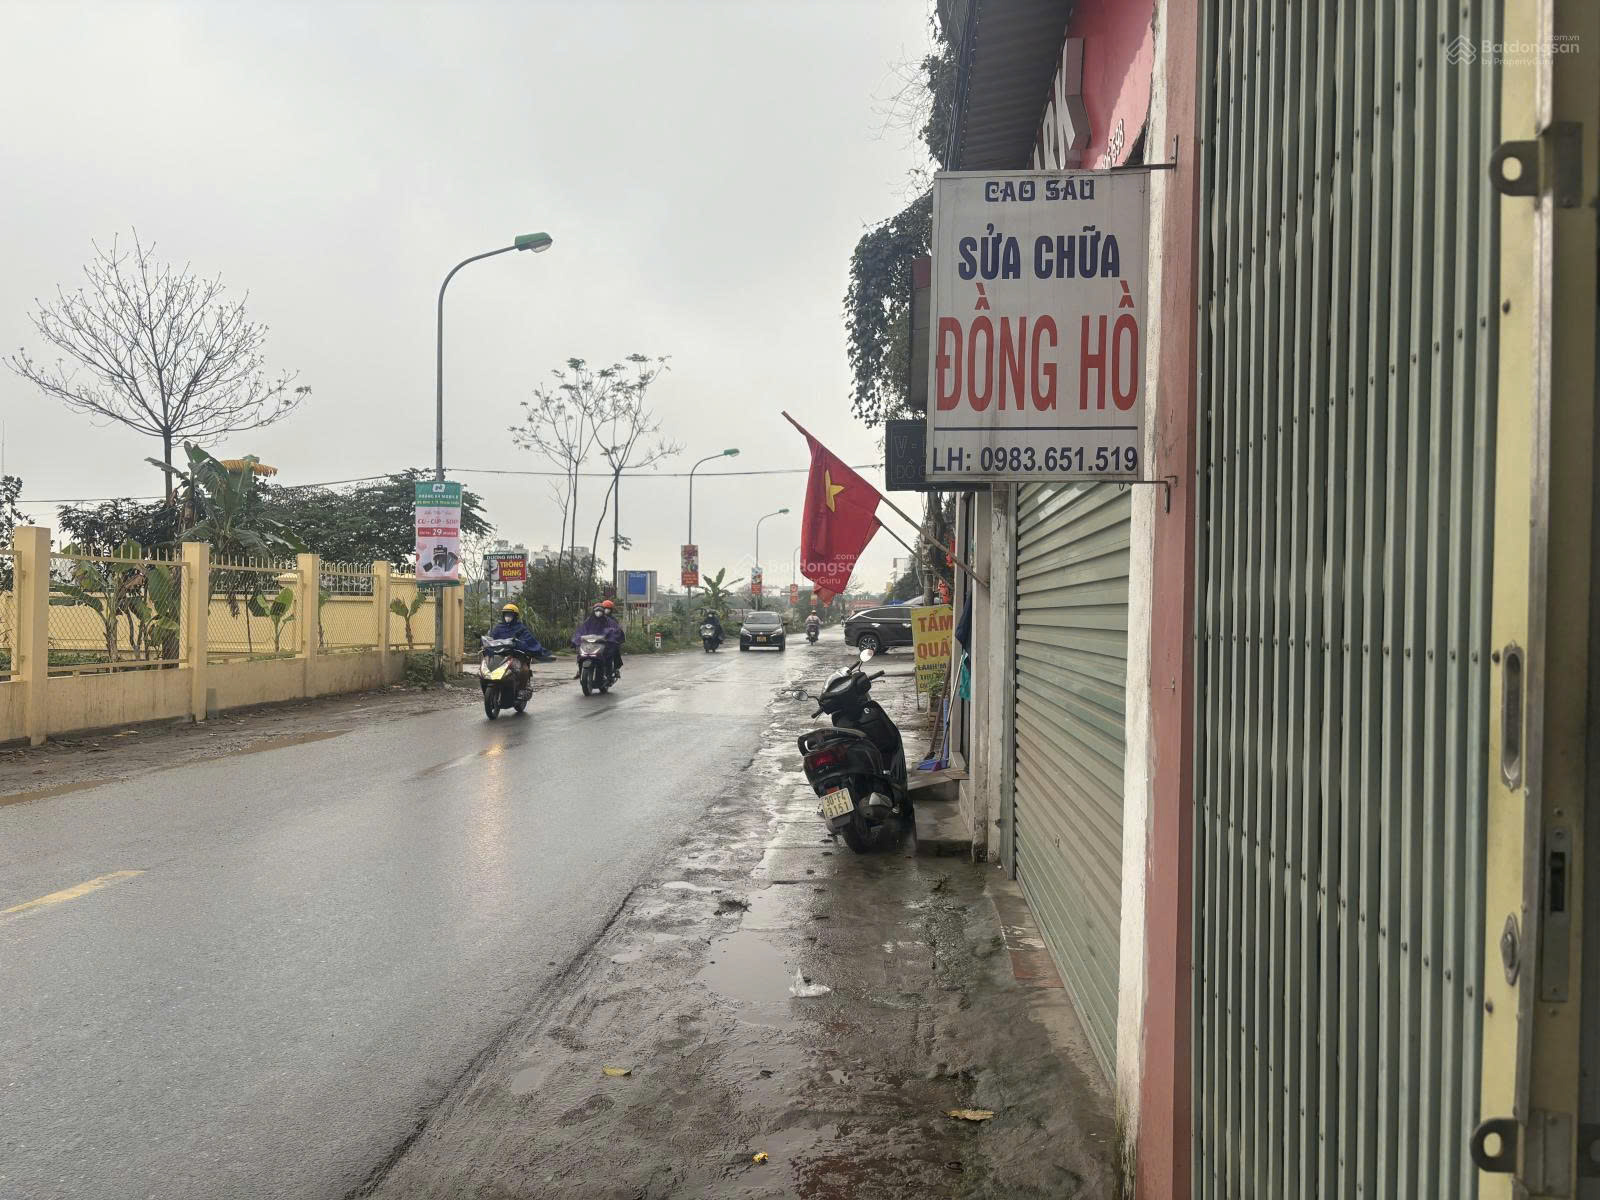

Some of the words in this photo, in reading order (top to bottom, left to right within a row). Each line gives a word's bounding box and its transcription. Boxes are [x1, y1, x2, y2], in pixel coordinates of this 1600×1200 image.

[984, 180, 1036, 202] CAO
[1045, 176, 1095, 201] SÁU
[958, 223, 1021, 280] SỬA
[1034, 225, 1120, 279] CHỮA
[935, 282, 1058, 411] ĐỒNG
[1079, 280, 1138, 411] HỒ
[932, 447, 971, 472] LH:
[980, 446, 1138, 472] 0983.651.519
[917, 607, 953, 632] TẨM
[917, 635, 952, 660] QUẤ
